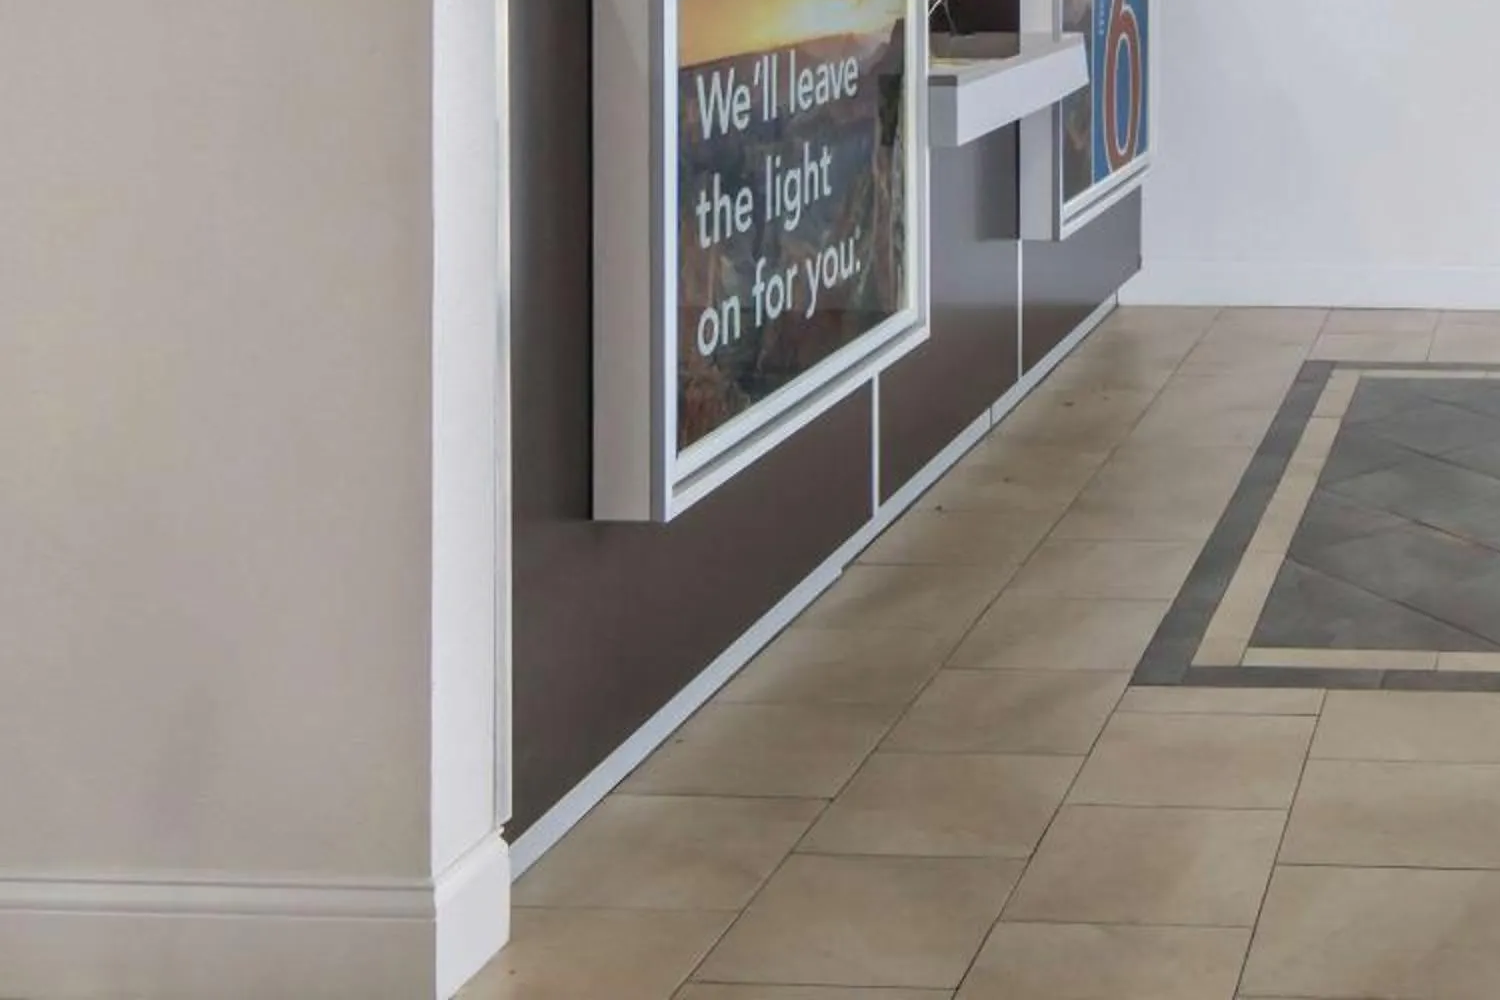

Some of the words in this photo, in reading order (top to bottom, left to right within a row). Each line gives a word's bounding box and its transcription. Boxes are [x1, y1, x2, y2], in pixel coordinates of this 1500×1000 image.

[697, 53, 778, 140] We'll
[789, 48, 859, 113] leave
[696, 172, 753, 249] the
[766, 141, 832, 231] light
[697, 295, 741, 356] on
[752, 256, 797, 328] for
